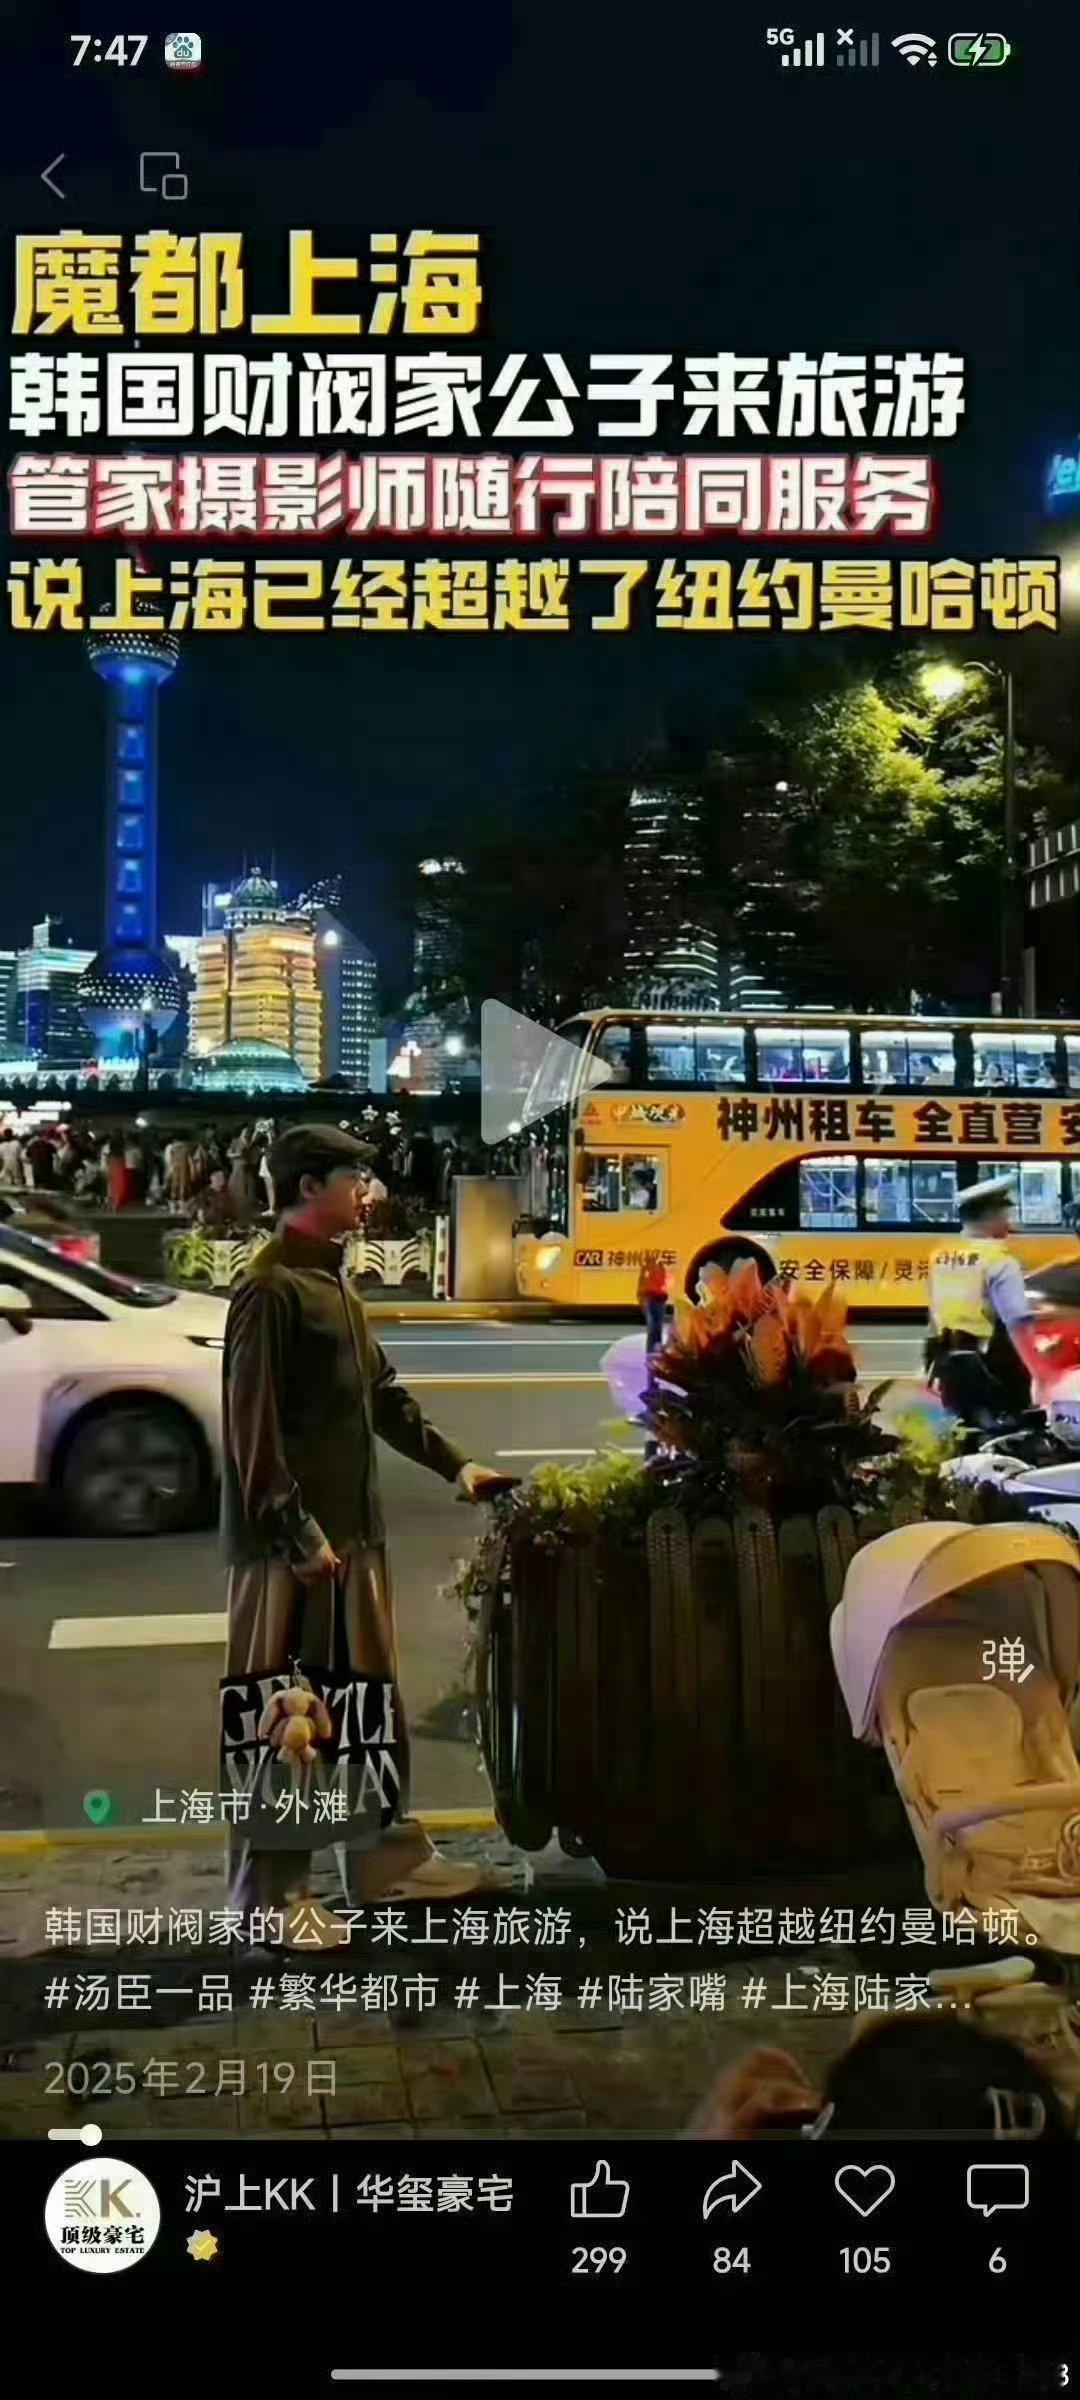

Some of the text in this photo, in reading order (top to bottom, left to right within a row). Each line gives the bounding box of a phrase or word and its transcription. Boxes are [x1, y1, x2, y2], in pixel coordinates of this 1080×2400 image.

[717, 1097, 896, 1142] 神州租车
[914, 1101, 1042, 1144] 全直营
[575, 1250, 602, 1266] CAR
